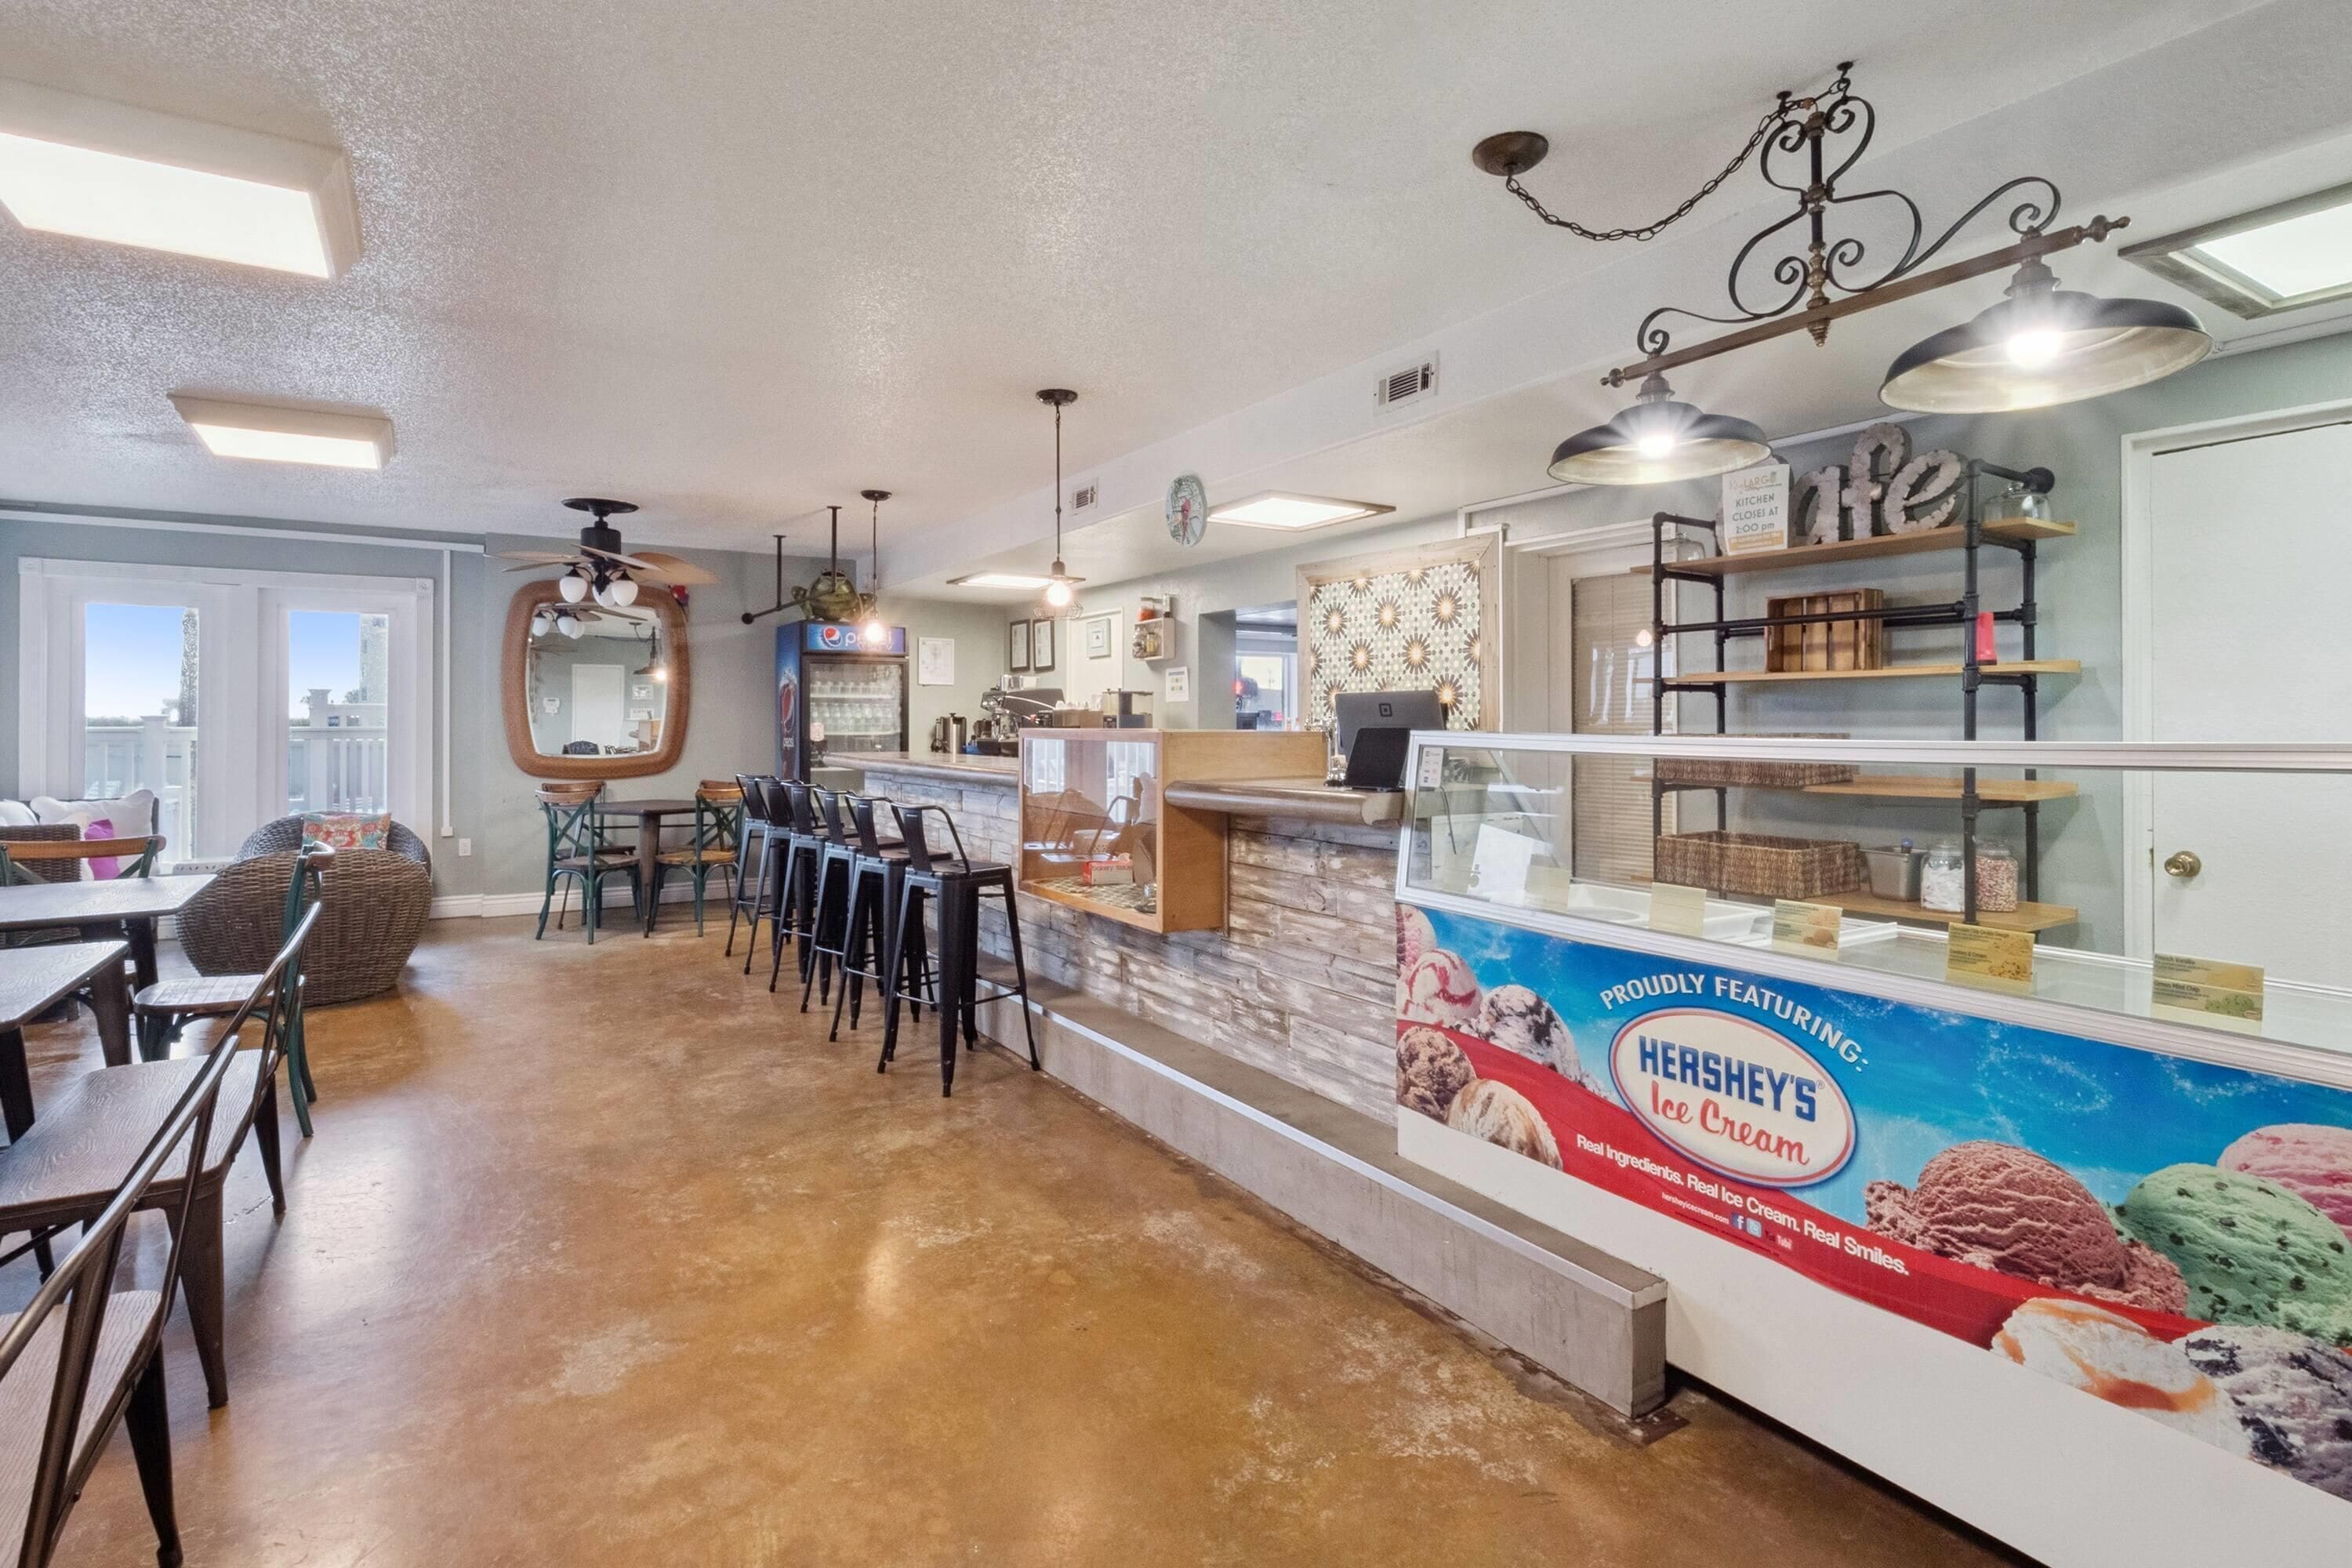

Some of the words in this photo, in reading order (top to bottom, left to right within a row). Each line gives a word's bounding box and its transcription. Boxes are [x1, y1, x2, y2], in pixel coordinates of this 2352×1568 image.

[1717, 423, 1962, 553] afe
[1732, 508, 1766, 521] CLOSES
[1768, 506, 1779, 516] AT
[1736, 493, 1775, 507] KITCHEN
[1762, 523, 1775, 532] pm
[1599, 974, 1705, 1011] PROUDLY
[1715, 976, 1869, 1073] FEATURING:
[1639, 1035, 1817, 1123] HERSHEY'S
[1650, 1080, 1693, 1124] Ice
[1700, 1098, 1810, 1166] Cream
[1577, 1133, 1604, 1155] Real
[1606, 1144, 1684, 1185] Ingredients.
[1687, 1173, 1718, 1199] Real
[1721, 1187, 1744, 1209] Ice
[1746, 1197, 1801, 1232] Cream.
[1803, 1221, 1840, 1248] Real
[1843, 1237, 1910, 1276] Smiles.
[1661, 1192, 1730, 1225] hersheyicecream.com
